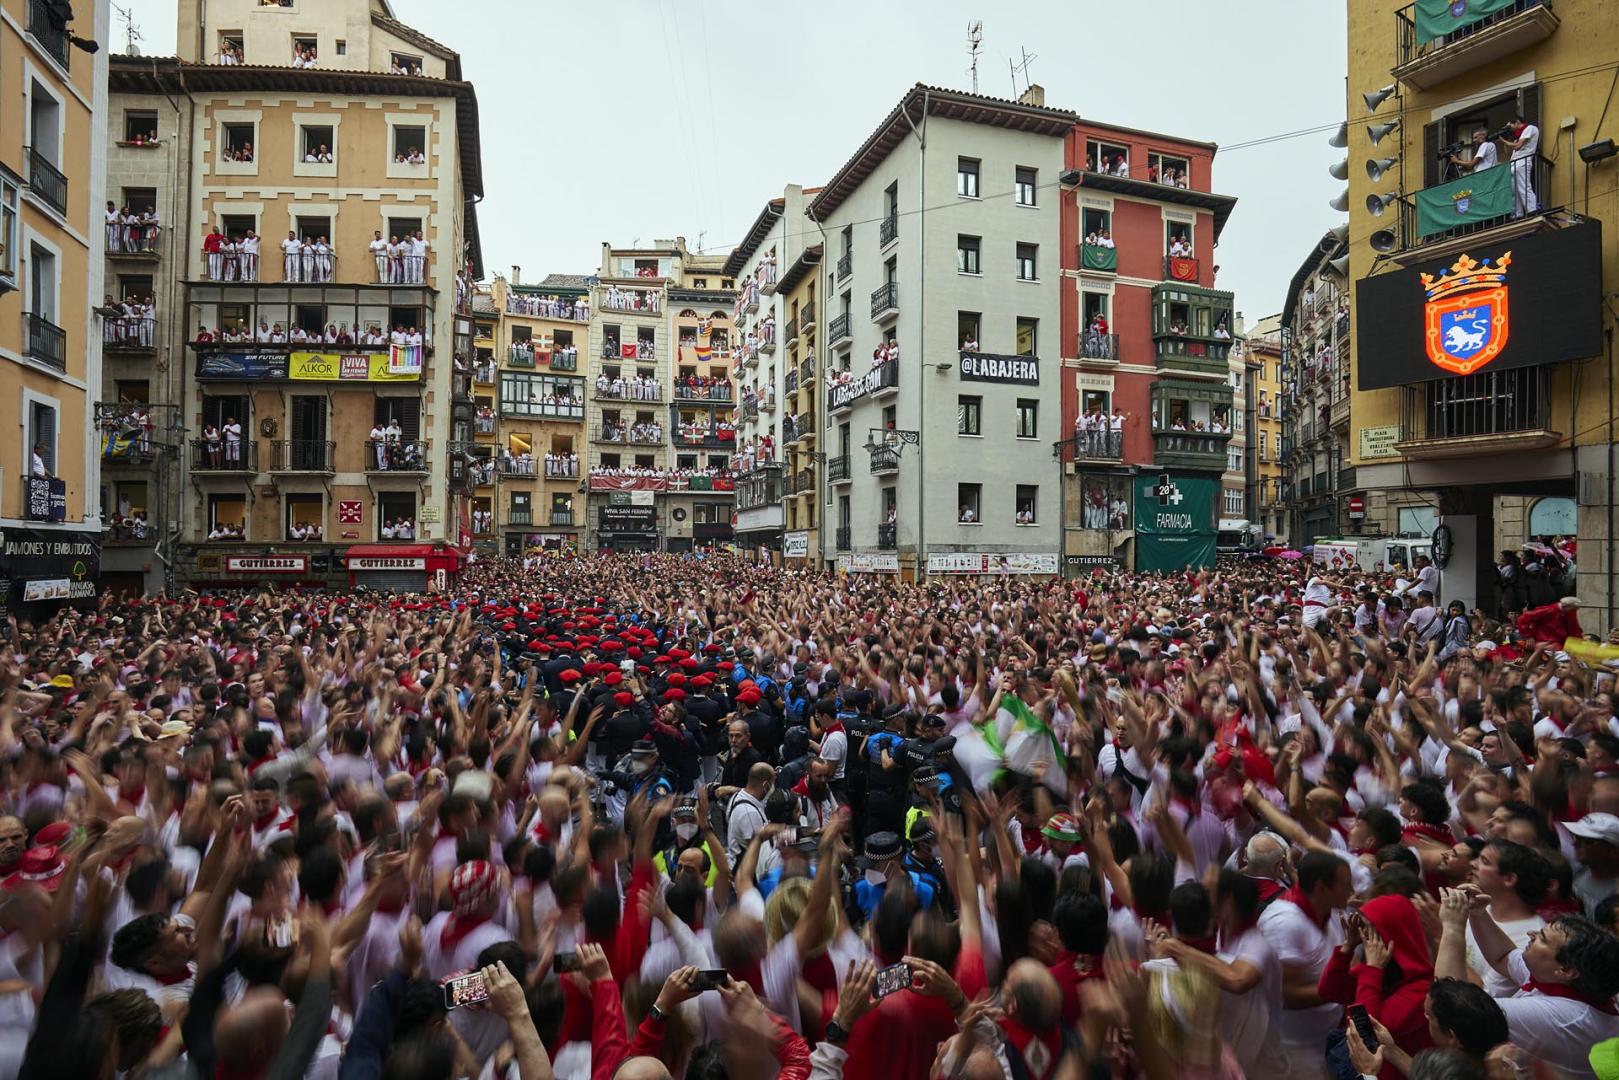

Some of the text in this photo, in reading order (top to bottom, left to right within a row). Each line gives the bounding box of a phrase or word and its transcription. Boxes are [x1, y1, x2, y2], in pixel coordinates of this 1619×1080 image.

[299, 364, 332, 374] ALKOR
[961, 357, 1038, 380] @LABAJERA
[1156, 513, 1192, 529] FARMACIA
[5, 541, 92, 555] JAMONES Y EMBUTIDOS
[239, 559, 295, 568] GUTIERREZ
[359, 559, 416, 568] GUTIERREZ
